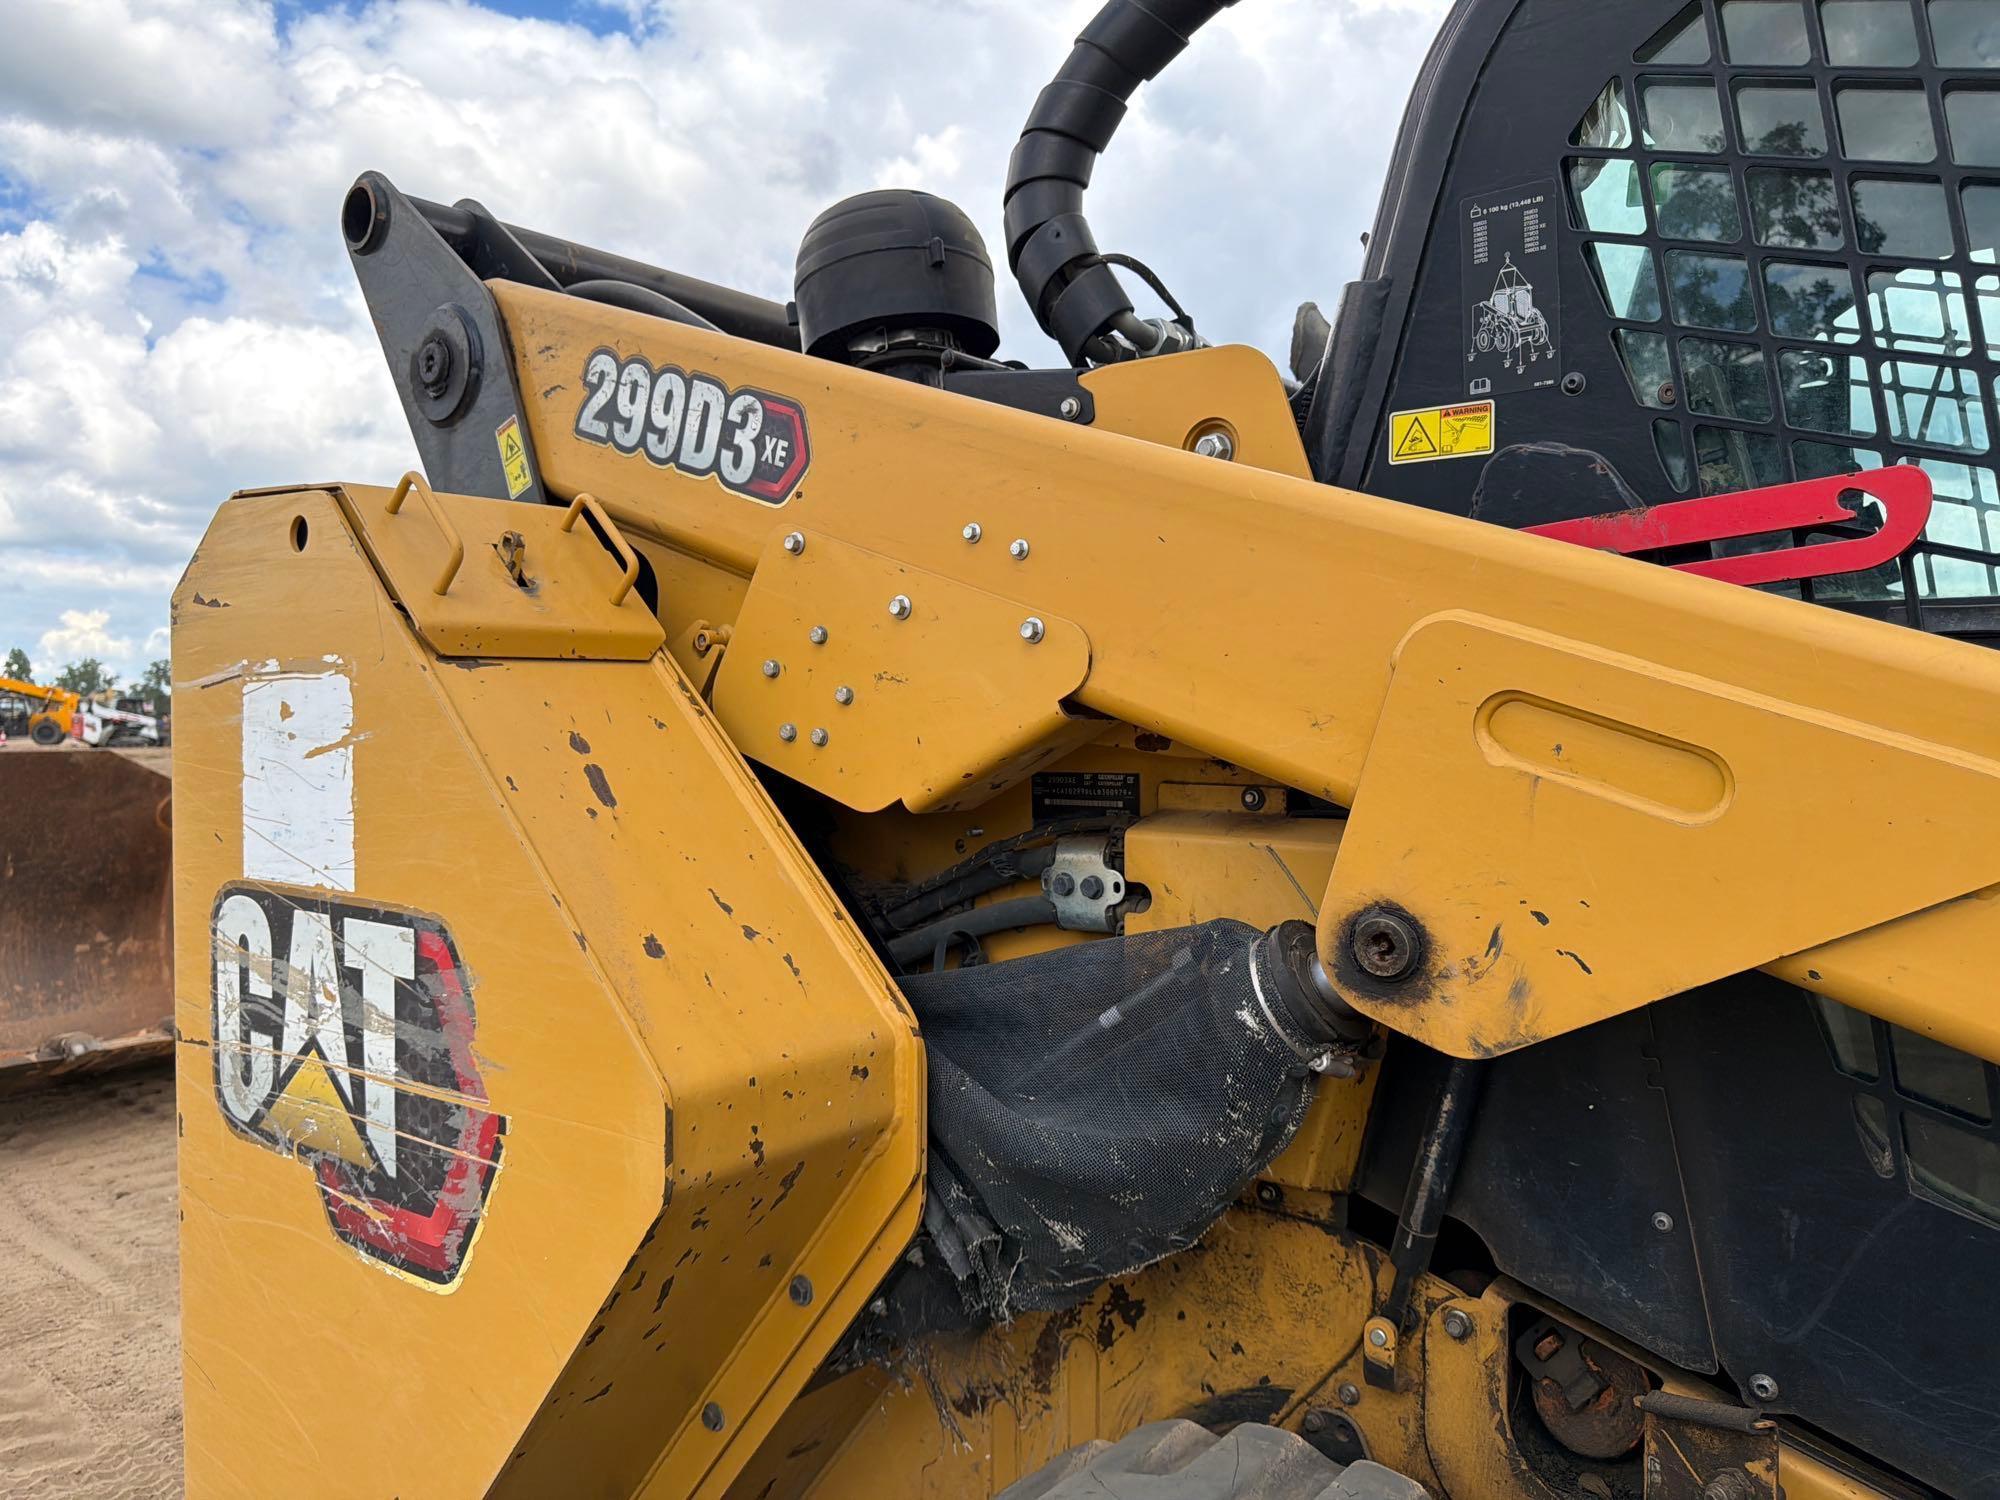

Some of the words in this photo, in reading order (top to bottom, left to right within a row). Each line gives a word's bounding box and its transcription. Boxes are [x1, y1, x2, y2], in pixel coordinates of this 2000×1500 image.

[1488, 205, 1500, 214] 100
[1500, 204, 1508, 212] kg
[1532, 195, 1544, 204] LB)
[577, 353, 764, 485] 299D3
[760, 434, 789, 468] XE
[1452, 405, 1489, 416] WARNING
[217, 894, 416, 1178] CAT
